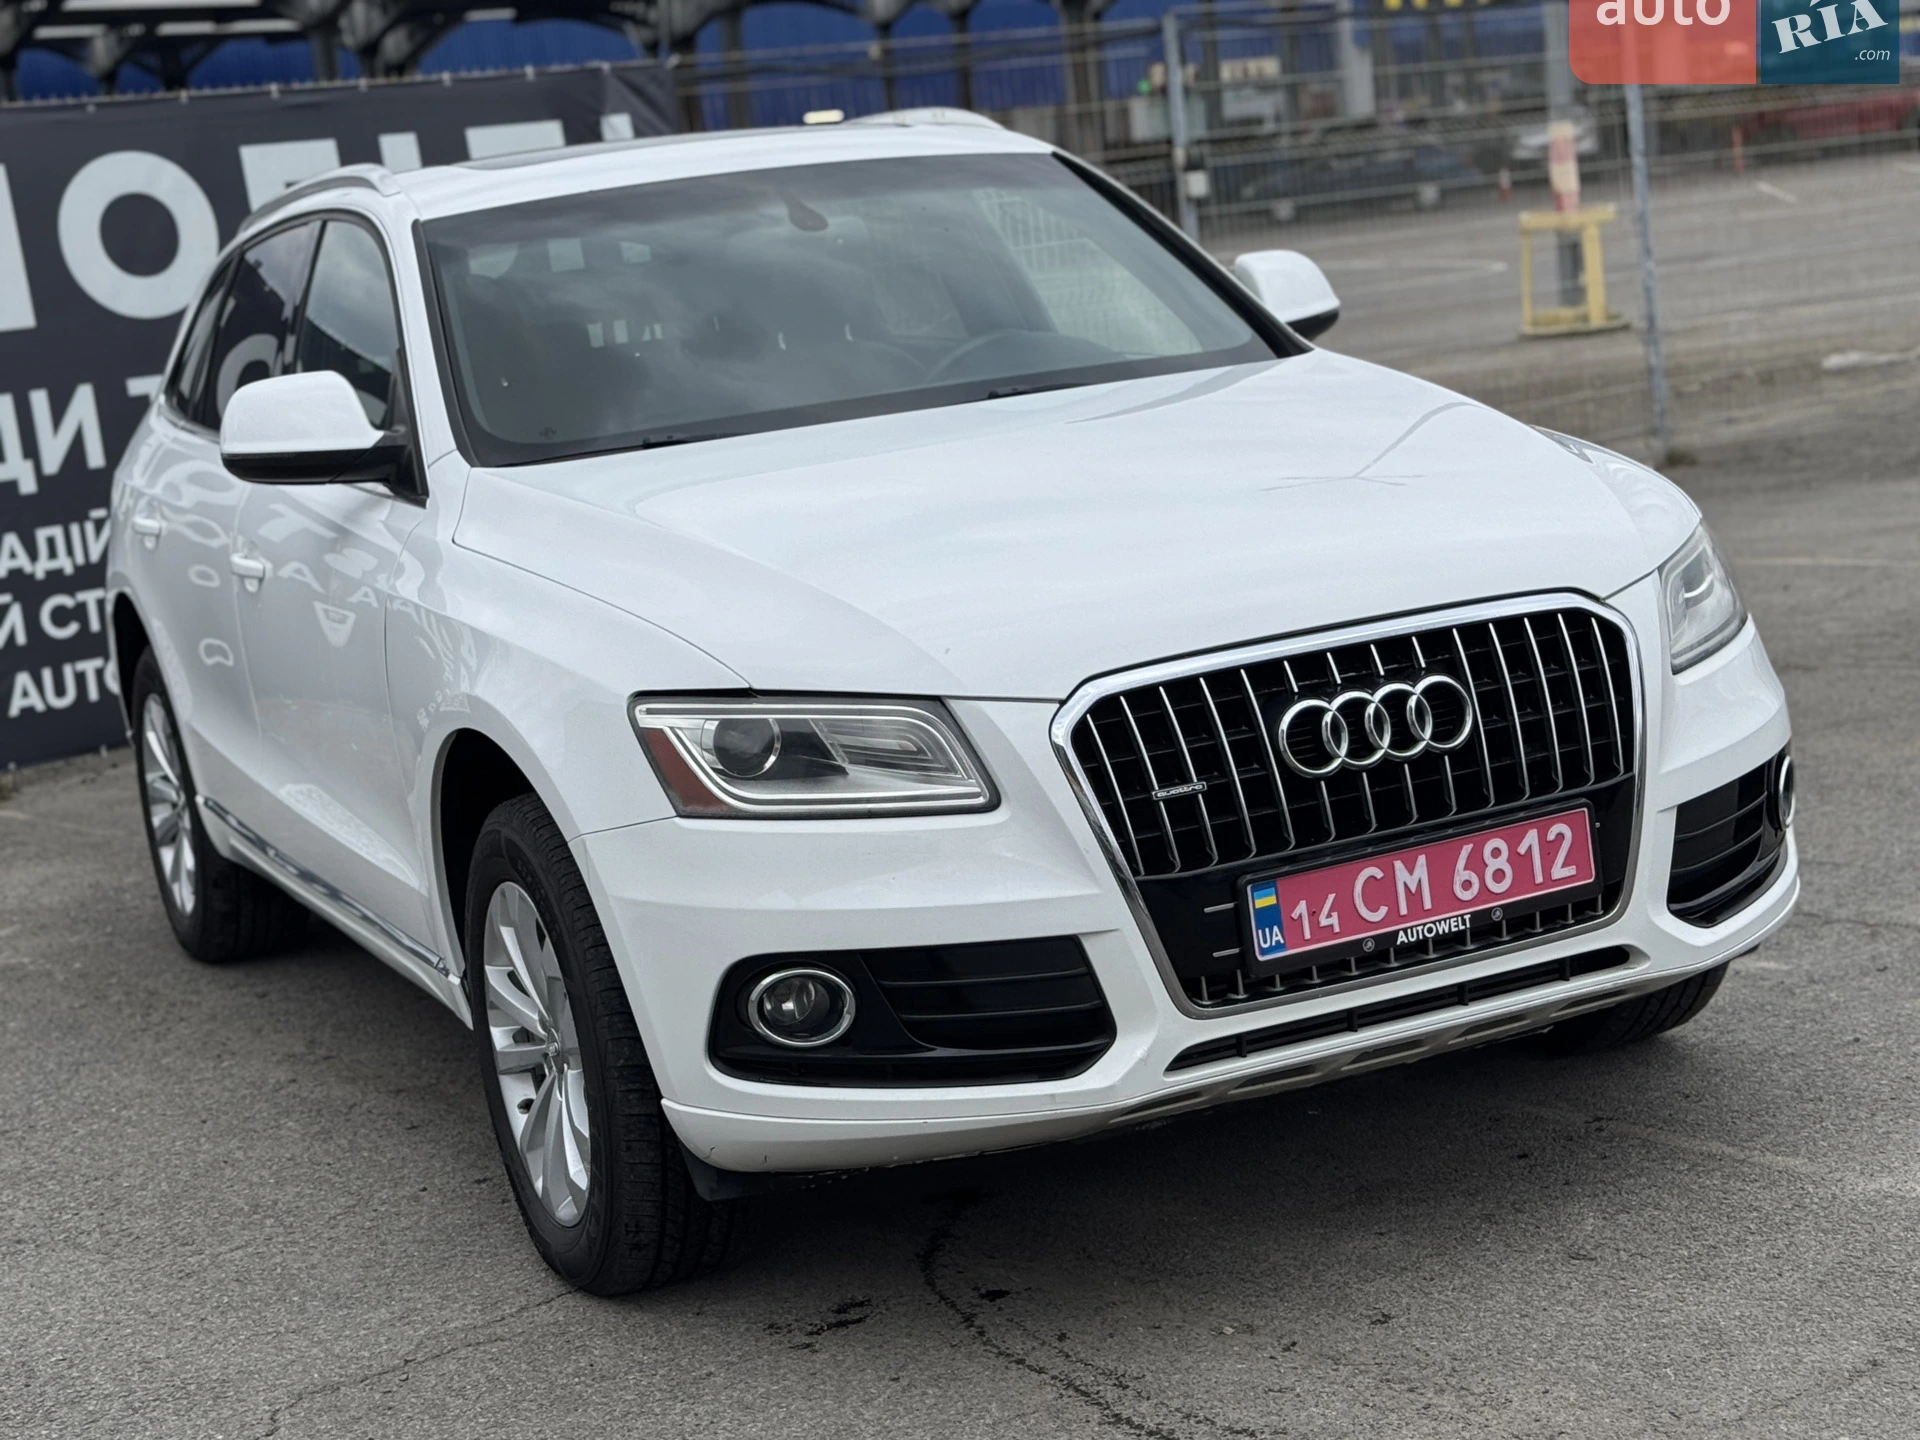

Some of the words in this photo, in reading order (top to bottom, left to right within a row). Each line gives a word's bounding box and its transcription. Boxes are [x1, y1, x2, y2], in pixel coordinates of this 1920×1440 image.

[1157, 784, 1203, 797] quattro
[1290, 893, 1341, 941] 14
[1353, 854, 1432, 923] CM
[1453, 823, 1577, 902] 6812
[1258, 925, 1285, 948] UA
[1396, 914, 1471, 945] AUTOWELT
